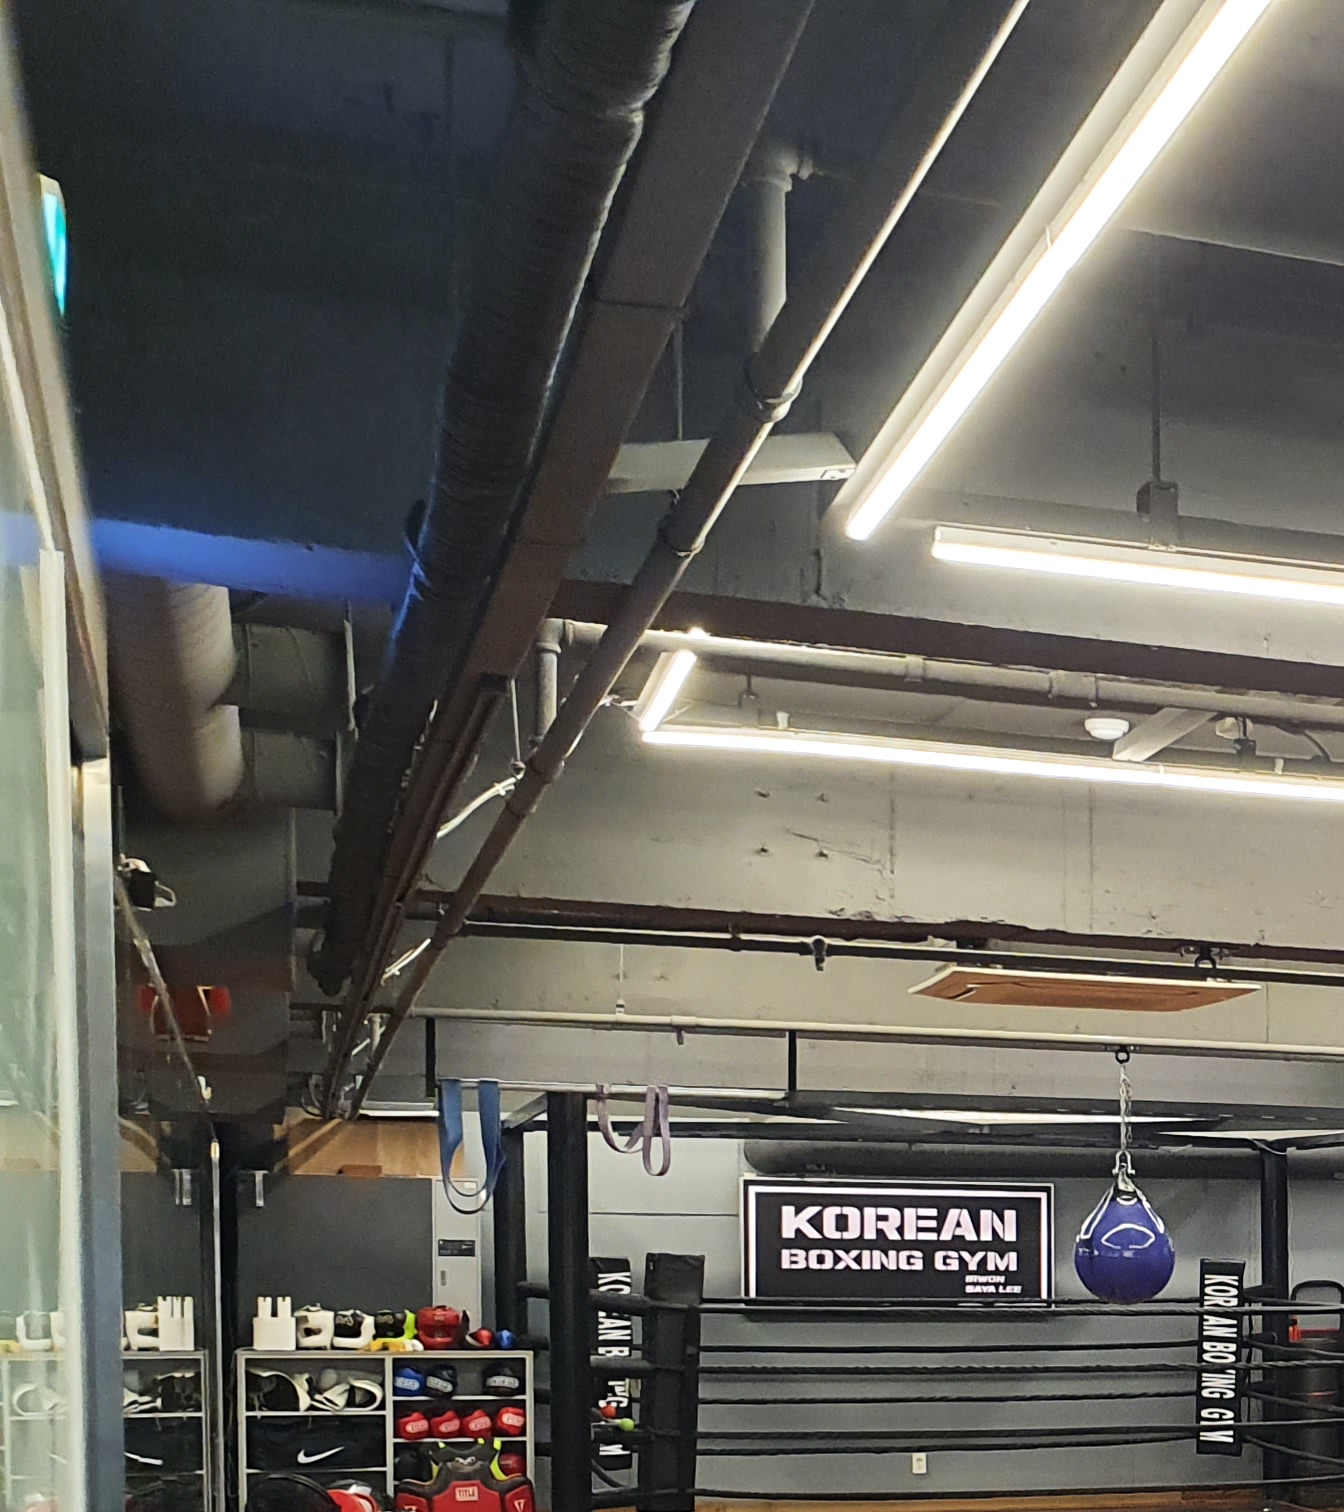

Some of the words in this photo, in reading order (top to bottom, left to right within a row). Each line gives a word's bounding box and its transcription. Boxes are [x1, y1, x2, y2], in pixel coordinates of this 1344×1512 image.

[781, 1205, 1017, 1241] KOREAN
[781, 1249, 923, 1270] BOXING
[934, 1251, 1017, 1271] GYM
[999, 1285, 1022, 1293] LEE
[1202, 1274, 1239, 1338] KORAN
[1201, 1341, 1237, 1399] BOING
